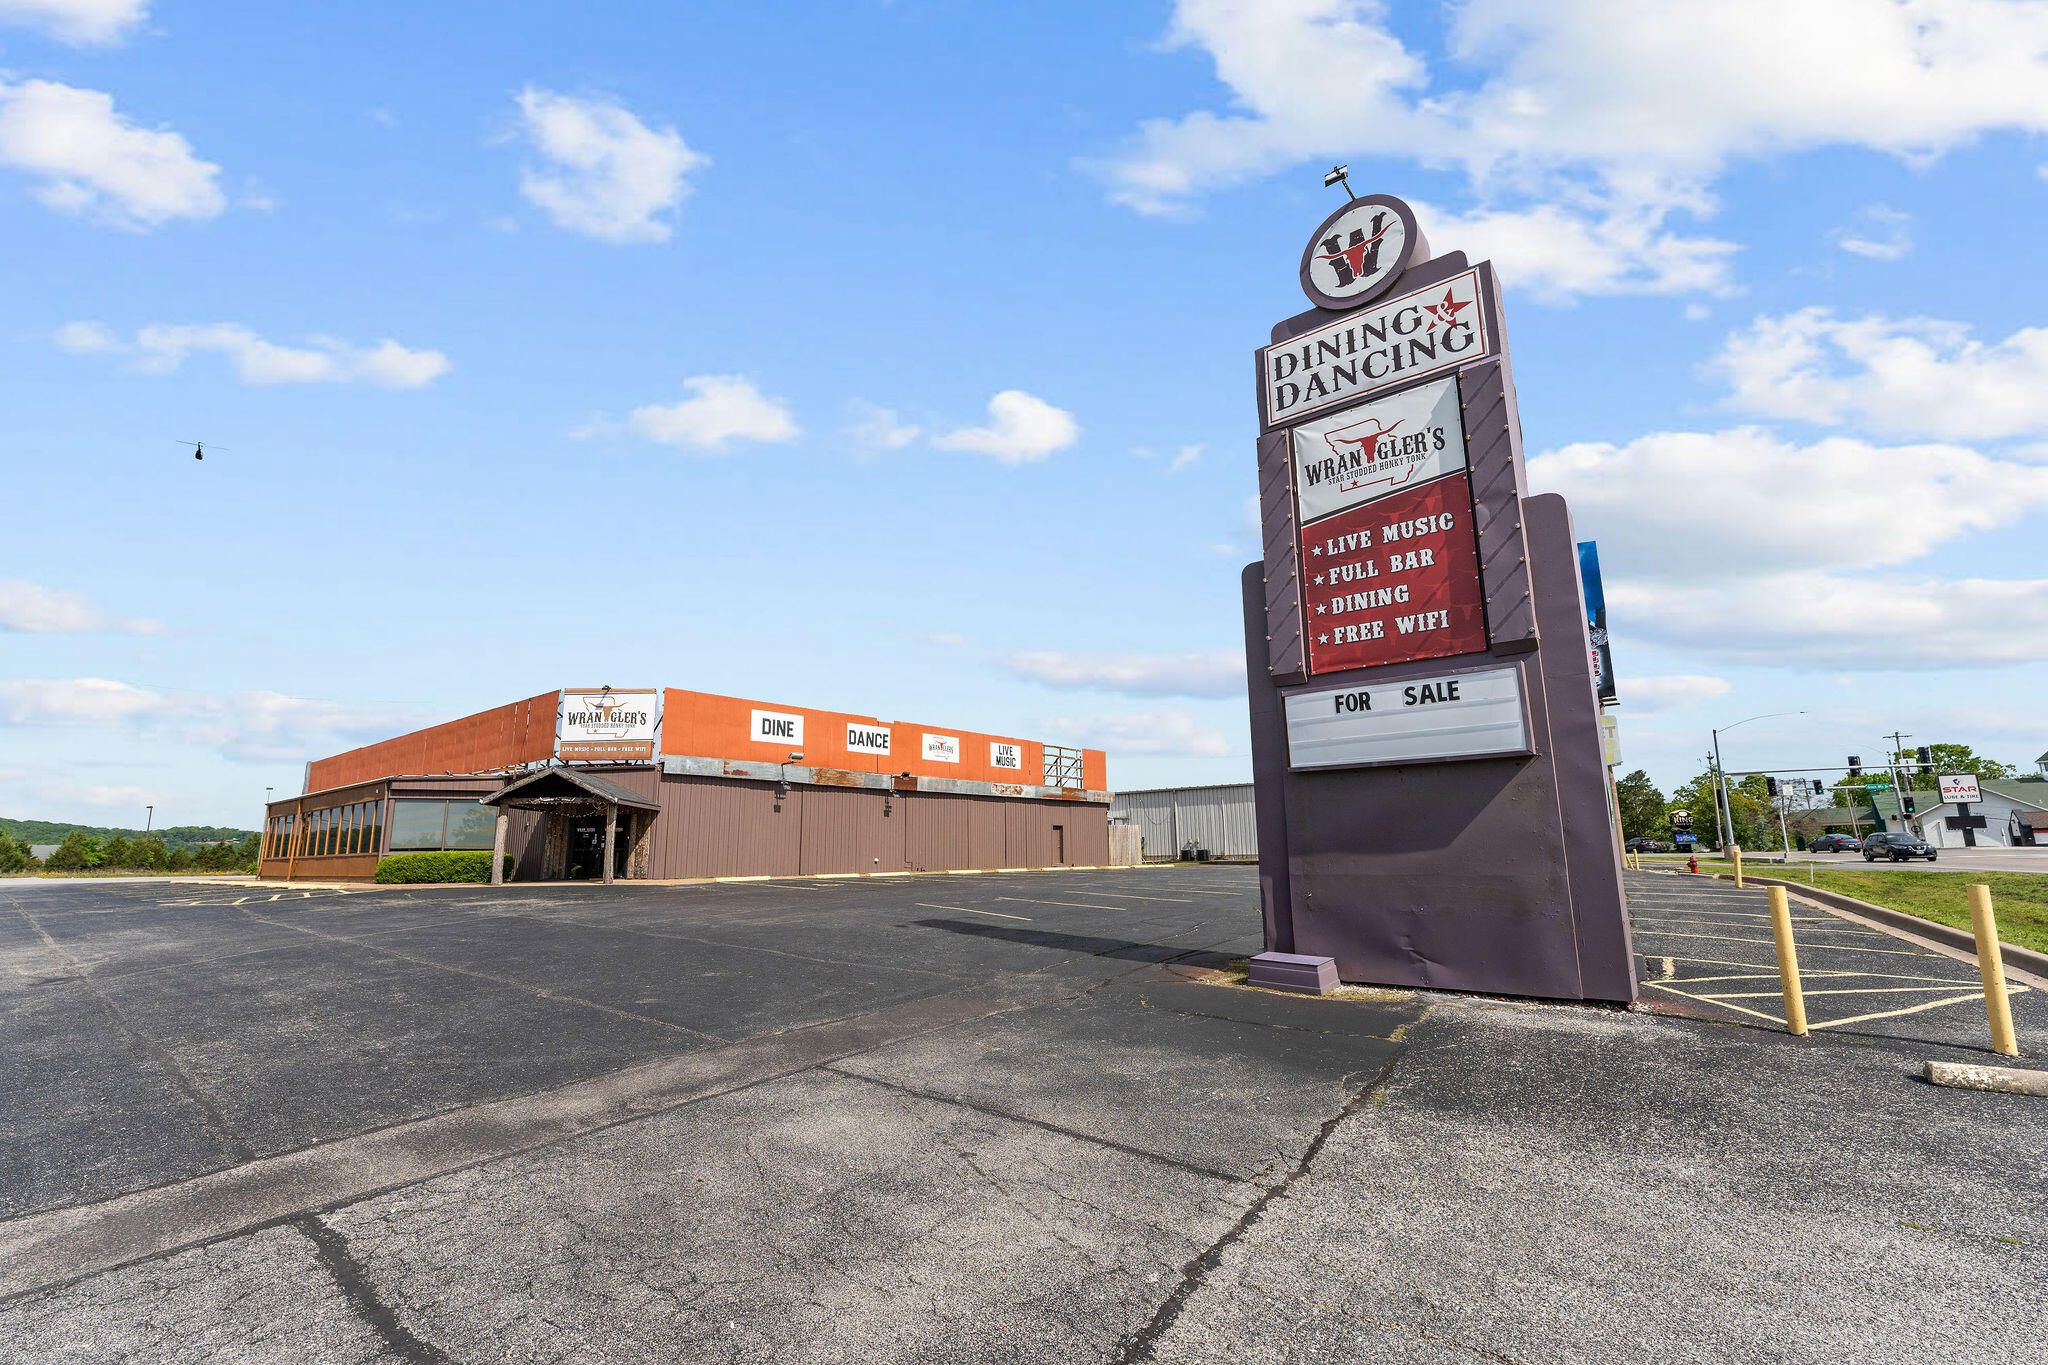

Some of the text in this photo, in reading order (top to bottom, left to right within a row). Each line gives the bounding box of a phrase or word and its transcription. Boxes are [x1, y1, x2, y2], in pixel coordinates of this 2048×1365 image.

[1273, 300, 1456, 382] DINING &
[1275, 320, 1475, 412] DANCING
[1304, 426, 1446, 487] WRANGLER'S
[1328, 452, 1426, 486] STAR STUDDED HONKY TONK
[1326, 511, 1455, 557] LIVE MUSIC
[1328, 548, 1435, 586] FULL BAR
[1330, 584, 1410, 616] DINING
[1333, 609, 1449, 645] FREE WIFI
[1334, 680, 1461, 714] FOR SALE
[567, 710, 647, 726] WRANGLER'S
[761, 717, 794, 738] DINE
[848, 729, 889, 749] DANCE
[998, 744, 1013, 756] LIVE
[995, 755, 1016, 768] MUSIC
[1942, 785, 1977, 793] STAR
